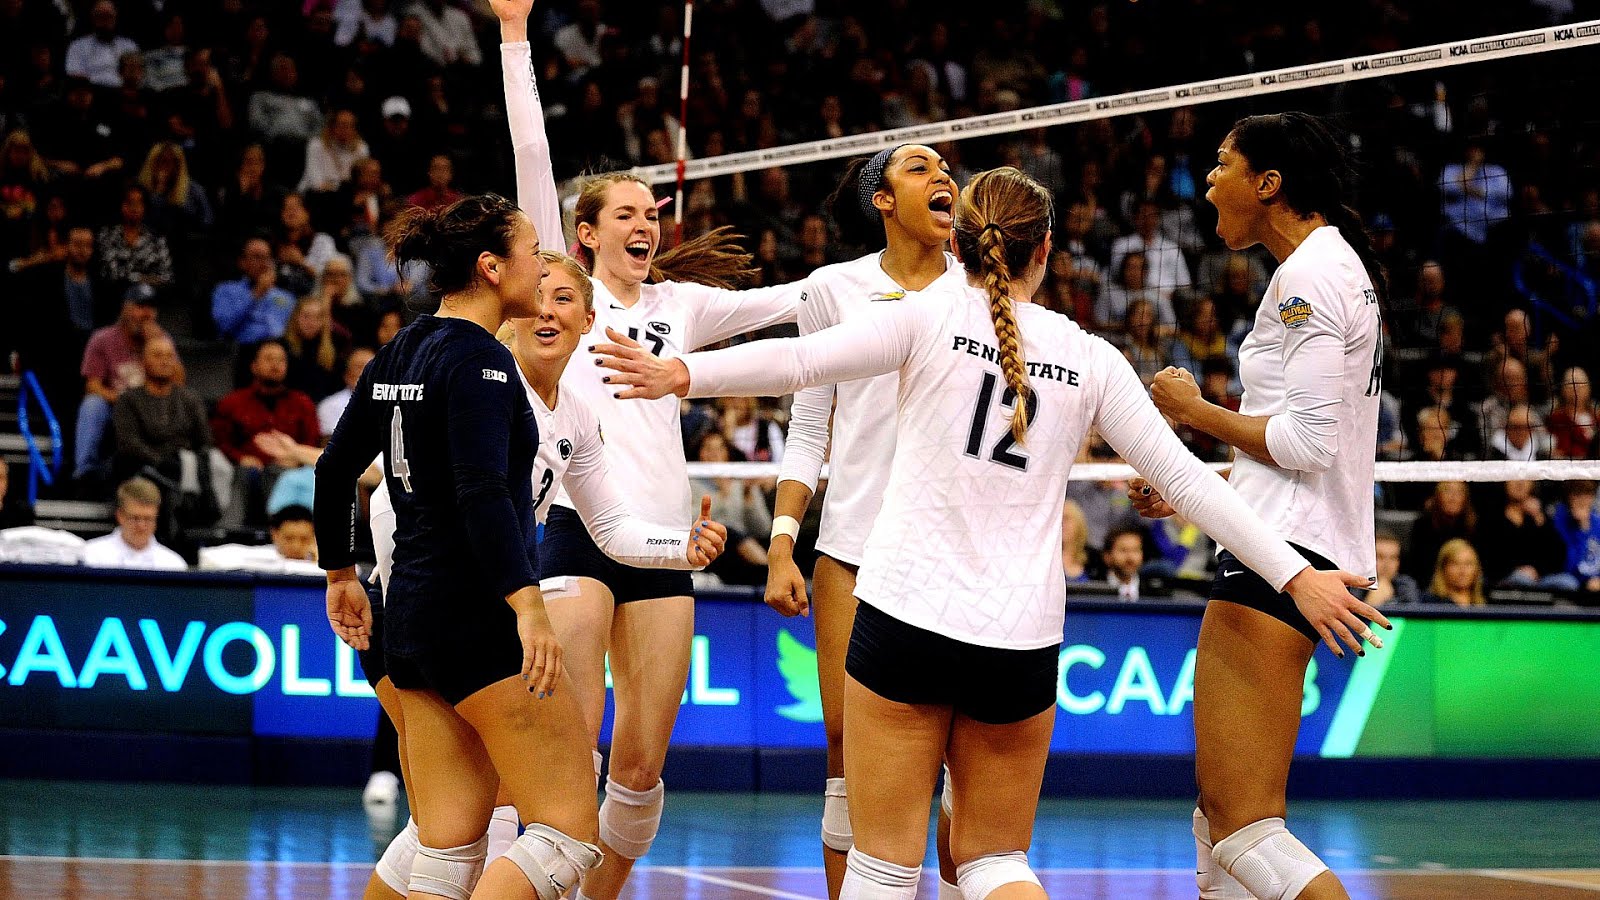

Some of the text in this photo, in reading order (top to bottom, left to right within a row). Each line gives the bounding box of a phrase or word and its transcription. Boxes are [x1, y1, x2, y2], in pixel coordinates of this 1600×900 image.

[1554, 29, 1575, 41] NCAA
[1449, 45, 1469, 57] NCAA
[1352, 60, 1370, 71] NCAA
[1261, 75, 1276, 85] NCAA
[1024, 361, 1079, 388] TATE
[963, 370, 1040, 472] 12
[391, 405, 413, 493] 4
